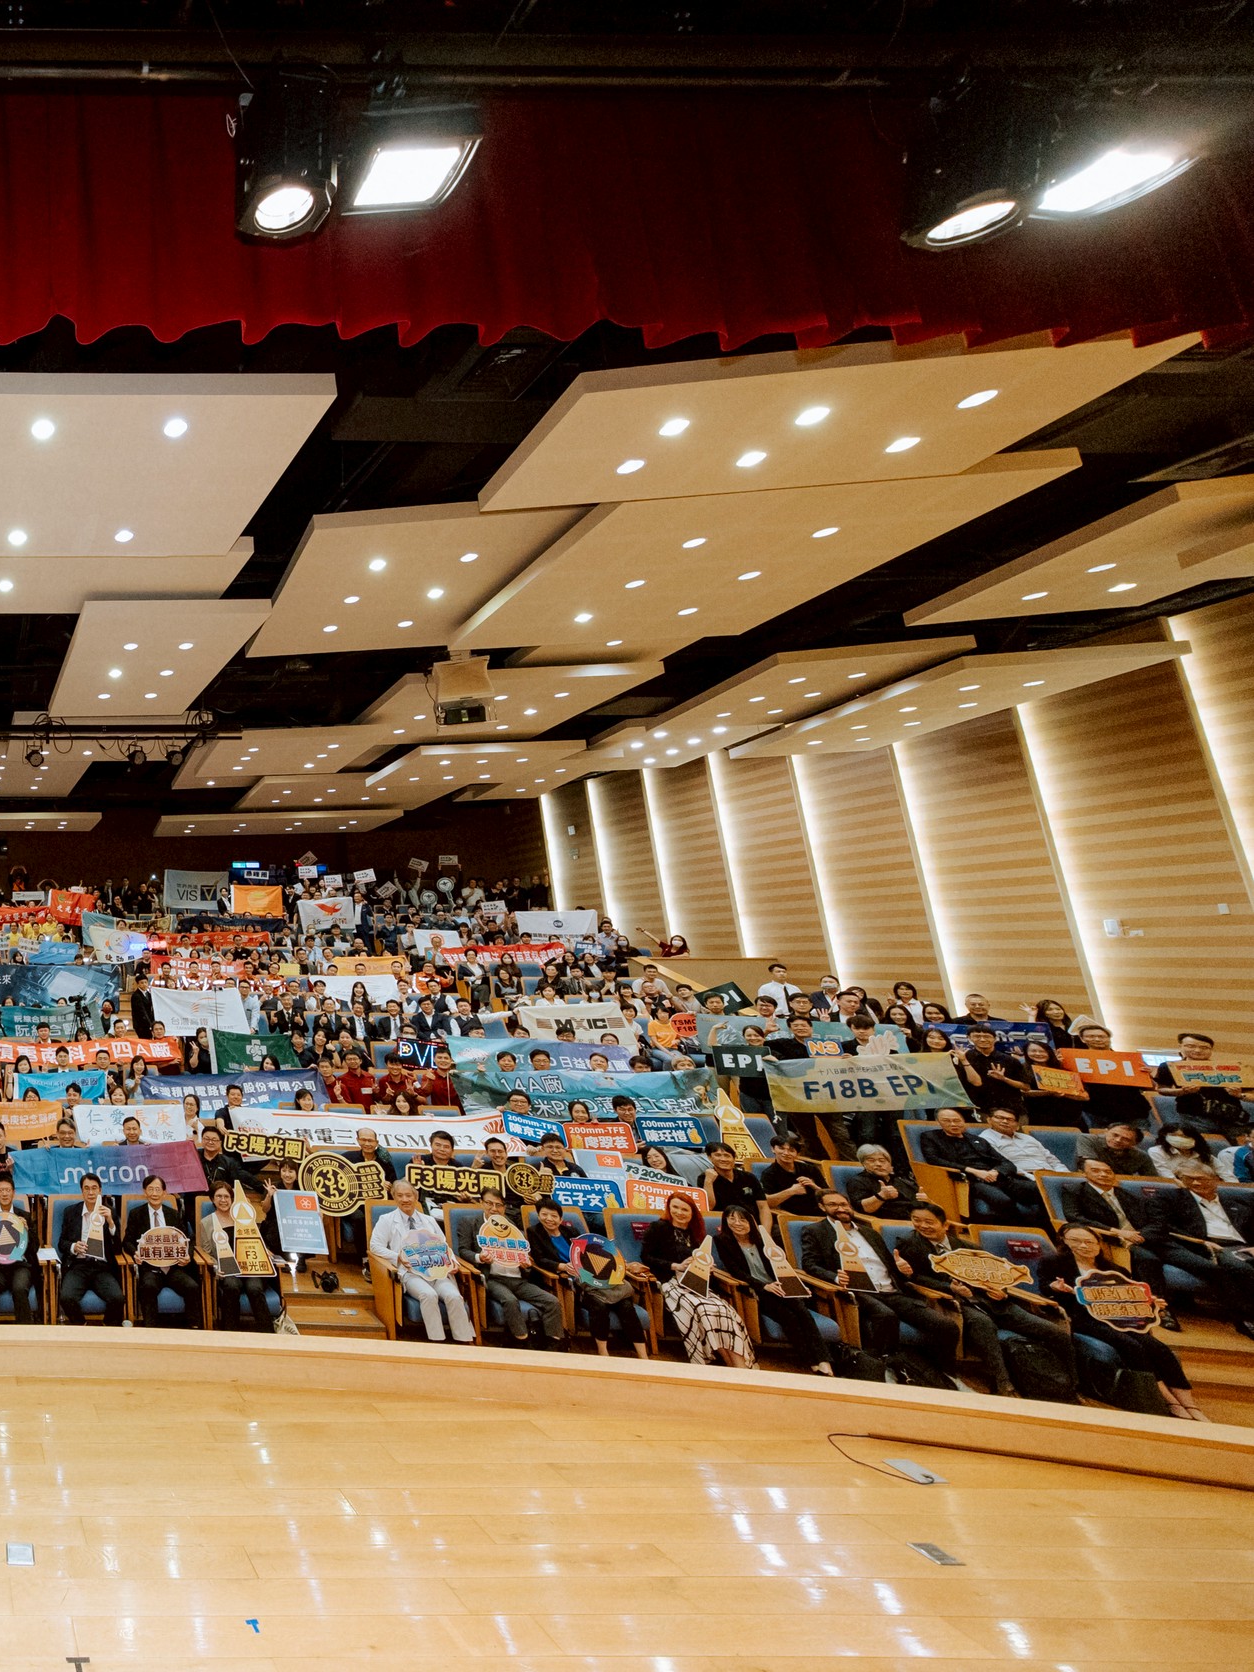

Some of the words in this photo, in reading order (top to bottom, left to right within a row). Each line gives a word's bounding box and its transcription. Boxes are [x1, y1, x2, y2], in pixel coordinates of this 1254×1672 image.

[176, 889, 198, 901] VIS
[554, 1017, 608, 1032] MXIC
[808, 1040, 840, 1056] N3
[722, 1053, 763, 1072] EPI
[1074, 1057, 1135, 1077] EPI
[150, 1080, 317, 1098] 台灣積體電路製股份有限公司
[803, 1078, 879, 1101] F18B
[887, 1074, 937, 1097] EPI
[507, 1114, 558, 1131] 200mm-TFE
[569, 1126, 626, 1135] 200mm-TFE
[641, 1120, 696, 1129] 200mm-TFE
[227, 1135, 304, 1159] F3陽光圈
[378, 1132, 429, 1148] TSM
[59, 1160, 149, 1184] micron
[309, 1159, 340, 1170] 200mm
[410, 1168, 500, 1192] F3陽光圈
[641, 1168, 685, 1187] 200mm
[554, 1181, 612, 1193] 200mm-PIE
[558, 1191, 604, 1207] 石子文
[144, 1233, 180, 1244] 追求品質
[139, 1245, 188, 1259] 唯有堅持
[245, 1250, 258, 1260] F3
